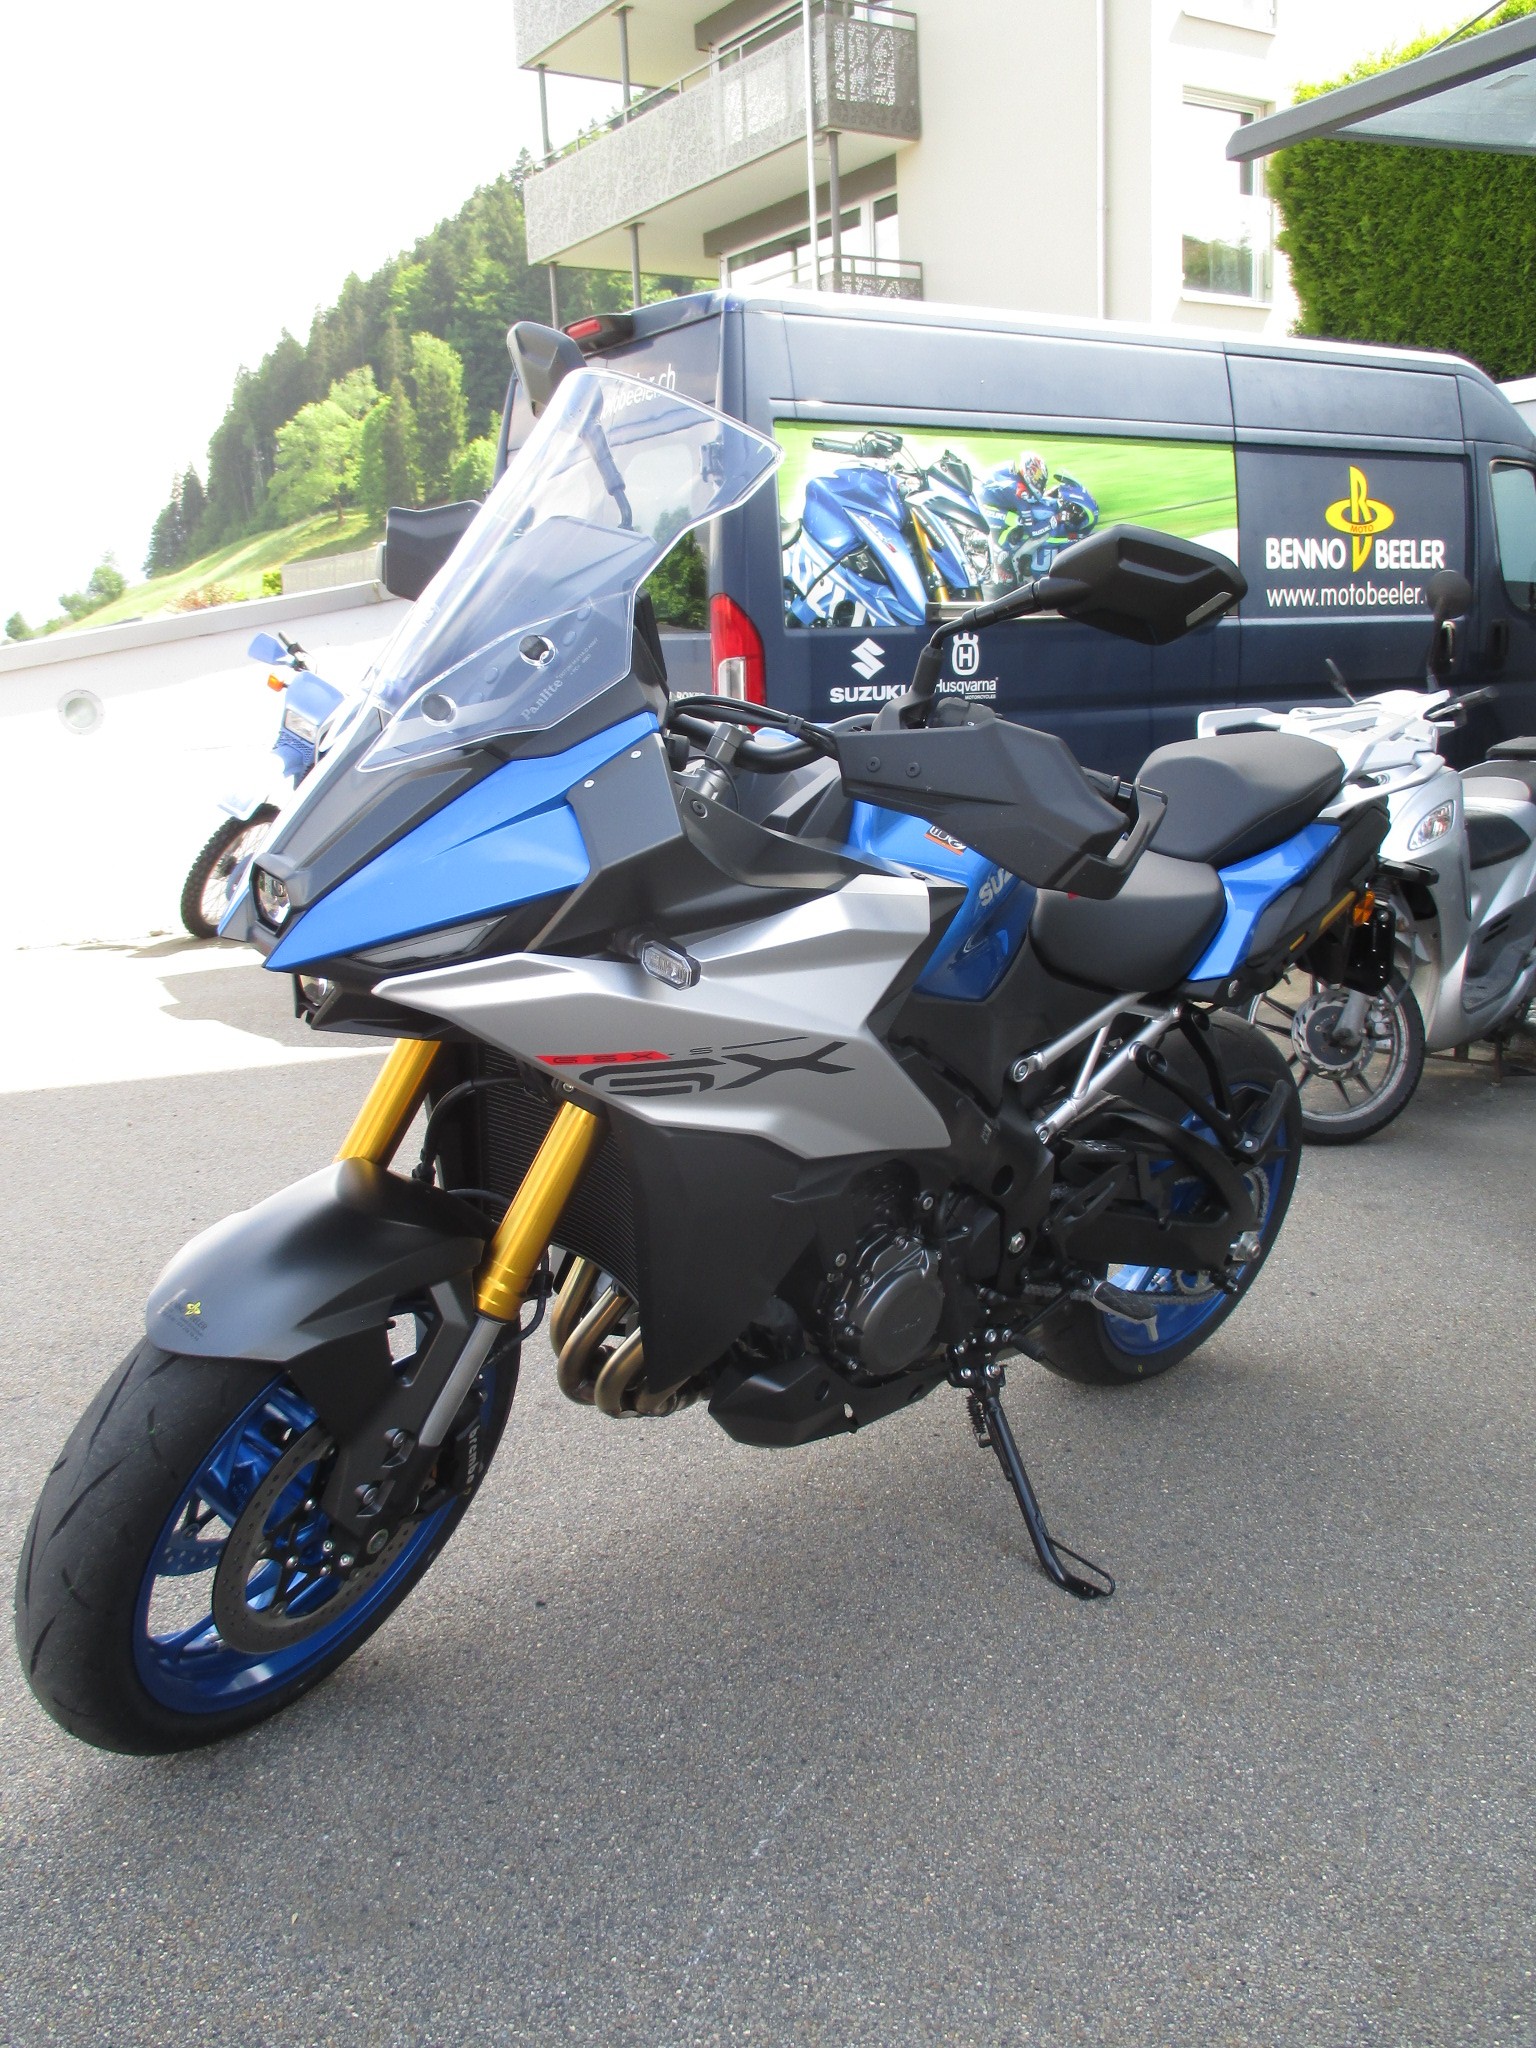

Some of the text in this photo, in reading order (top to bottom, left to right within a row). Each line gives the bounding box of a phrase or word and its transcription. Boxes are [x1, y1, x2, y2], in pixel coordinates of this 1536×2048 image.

[1350, 524, 1374, 534] MOTO
[1265, 537, 1445, 570] BENNO BEELER
[1266, 581, 1425, 608] www.motobeeler.
[520, 679, 563, 721] Panlite
[934, 677, 997, 695] Husqvarna
[466, 1425, 481, 1484] brembo
